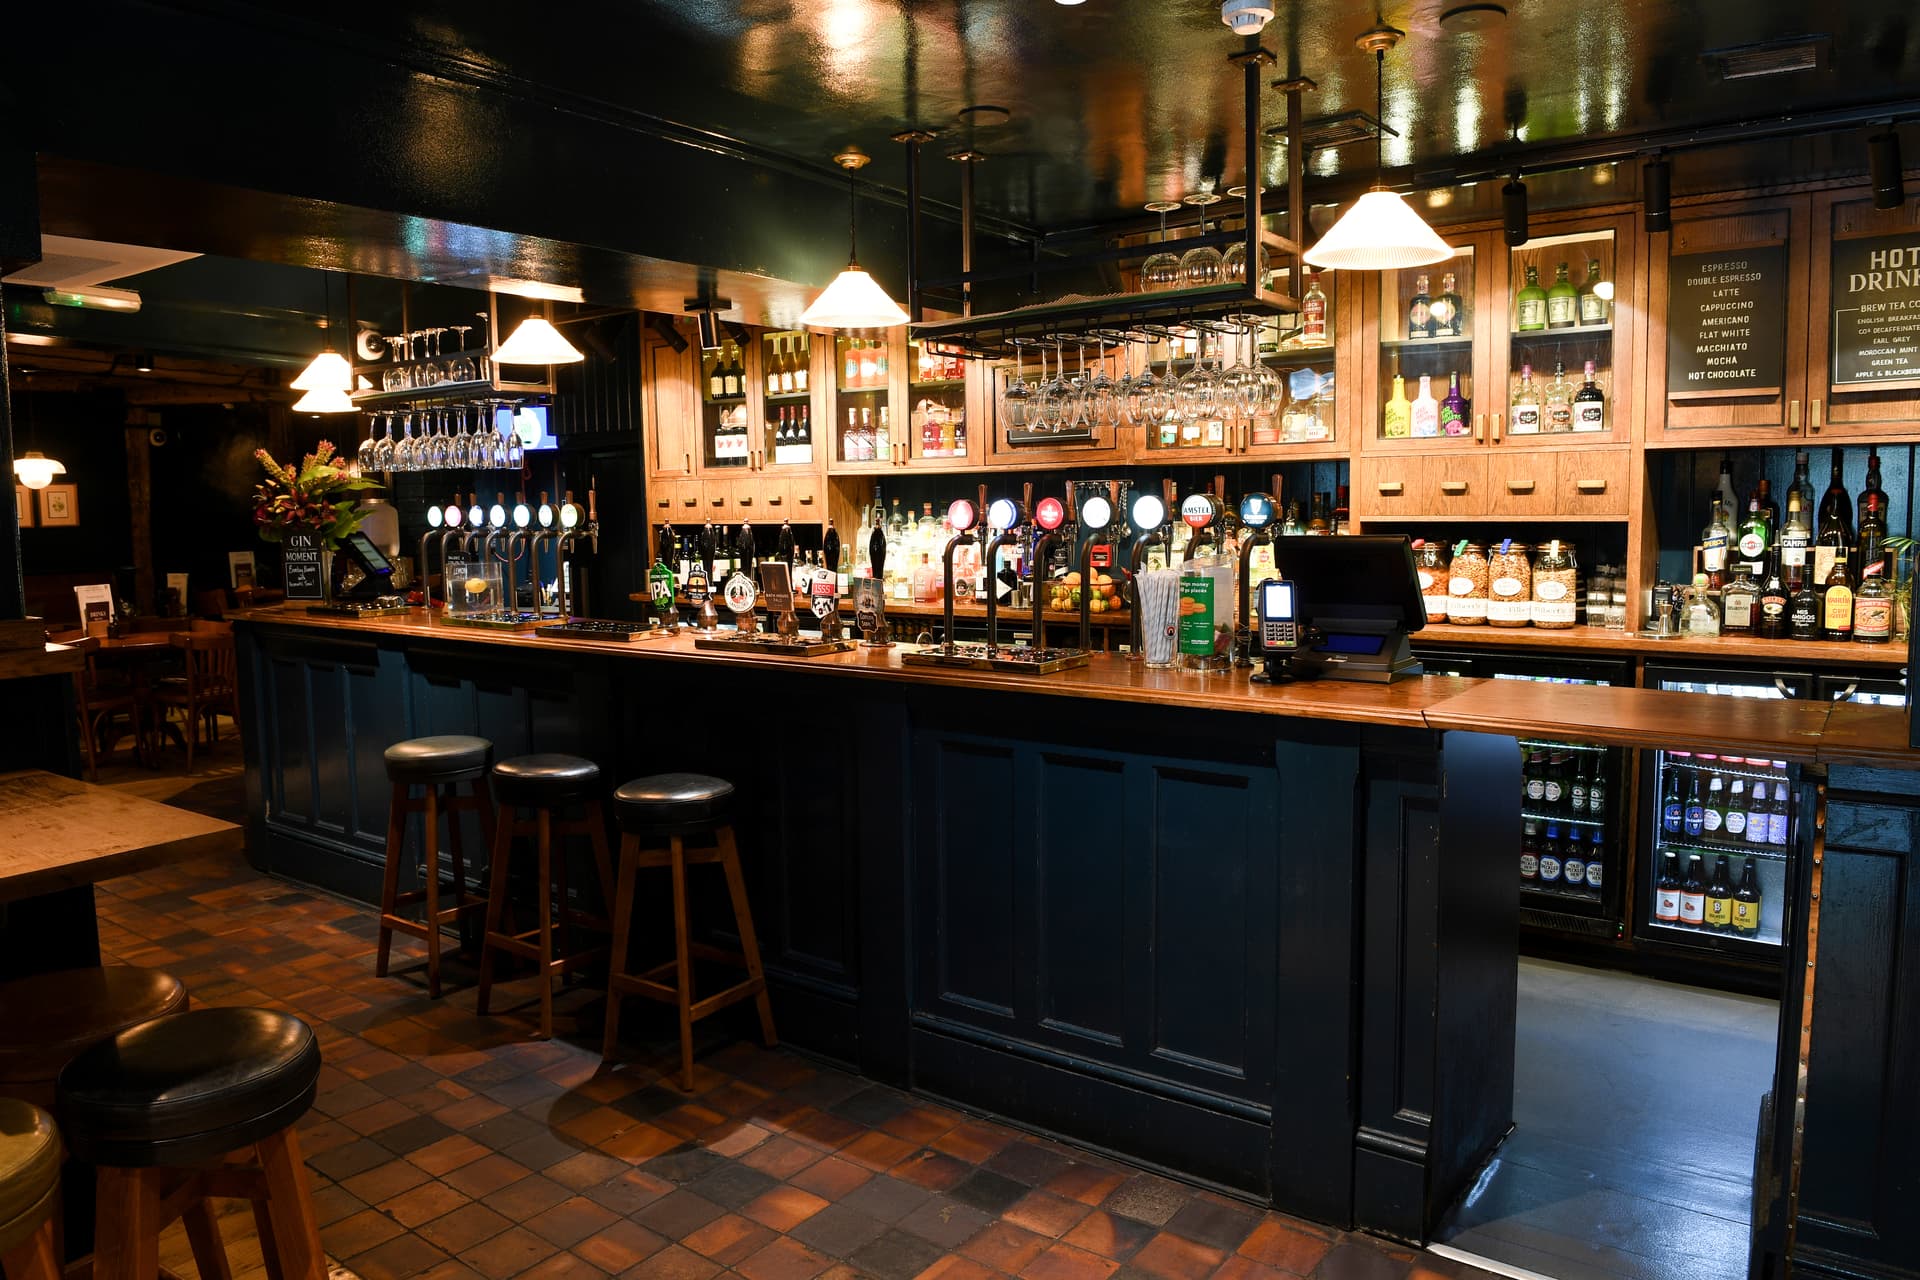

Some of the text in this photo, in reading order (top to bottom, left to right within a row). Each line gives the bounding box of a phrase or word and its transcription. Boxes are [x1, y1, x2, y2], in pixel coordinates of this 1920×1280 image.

[1871, 246, 1920, 270] HOT
[1701, 261, 1748, 273] ESPRESSO
[1687, 272, 1762, 287] DOUBLE ESPRESSO
[1713, 288, 1740, 298] LATTE
[1700, 301, 1754, 312] CAPPUCCINO
[1860, 303, 1886, 313] BREW
[1888, 301, 1906, 311] TEA
[1702, 315, 1750, 327] AMERICANO
[1857, 317, 1885, 325] ENGLISH
[1699, 328, 1751, 339] FLAT WHITE
[1873, 335, 1911, 345] EARL GREY
[1696, 342, 1748, 353] MACCHIATO
[1858, 346, 1919, 356] MOROCCAN MINT
[1706, 355, 1738, 366] MOCHA
[1871, 357, 1909, 366] GREEN TEA
[1688, 368, 1757, 380] HOT CHOCOLATE
[1183, 506, 1211, 514] AMSTEL
[290, 535, 312, 547] GIN
[285, 552, 318, 561] MOMENT
[650, 580, 672, 601] IPA
